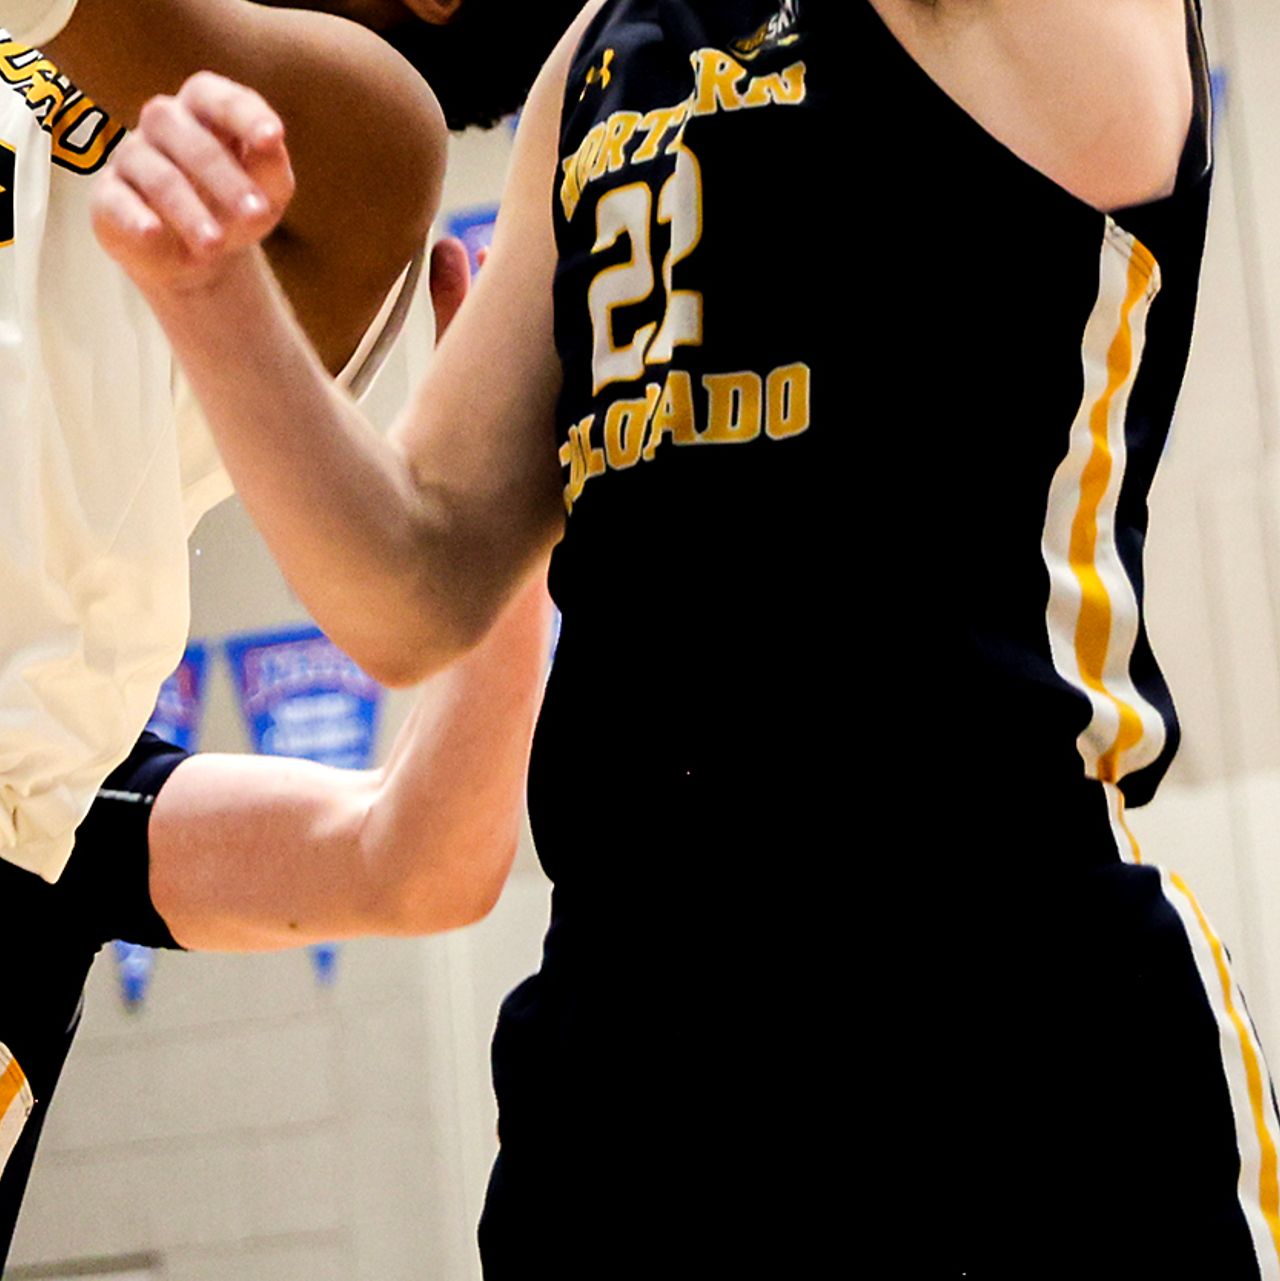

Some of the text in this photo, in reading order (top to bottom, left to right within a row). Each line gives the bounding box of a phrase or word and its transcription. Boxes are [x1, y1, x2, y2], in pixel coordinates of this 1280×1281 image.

[560, 47, 807, 222] NORTRN
[588, 143, 703, 396] 22
[559, 362, 810, 517] OLOADO
